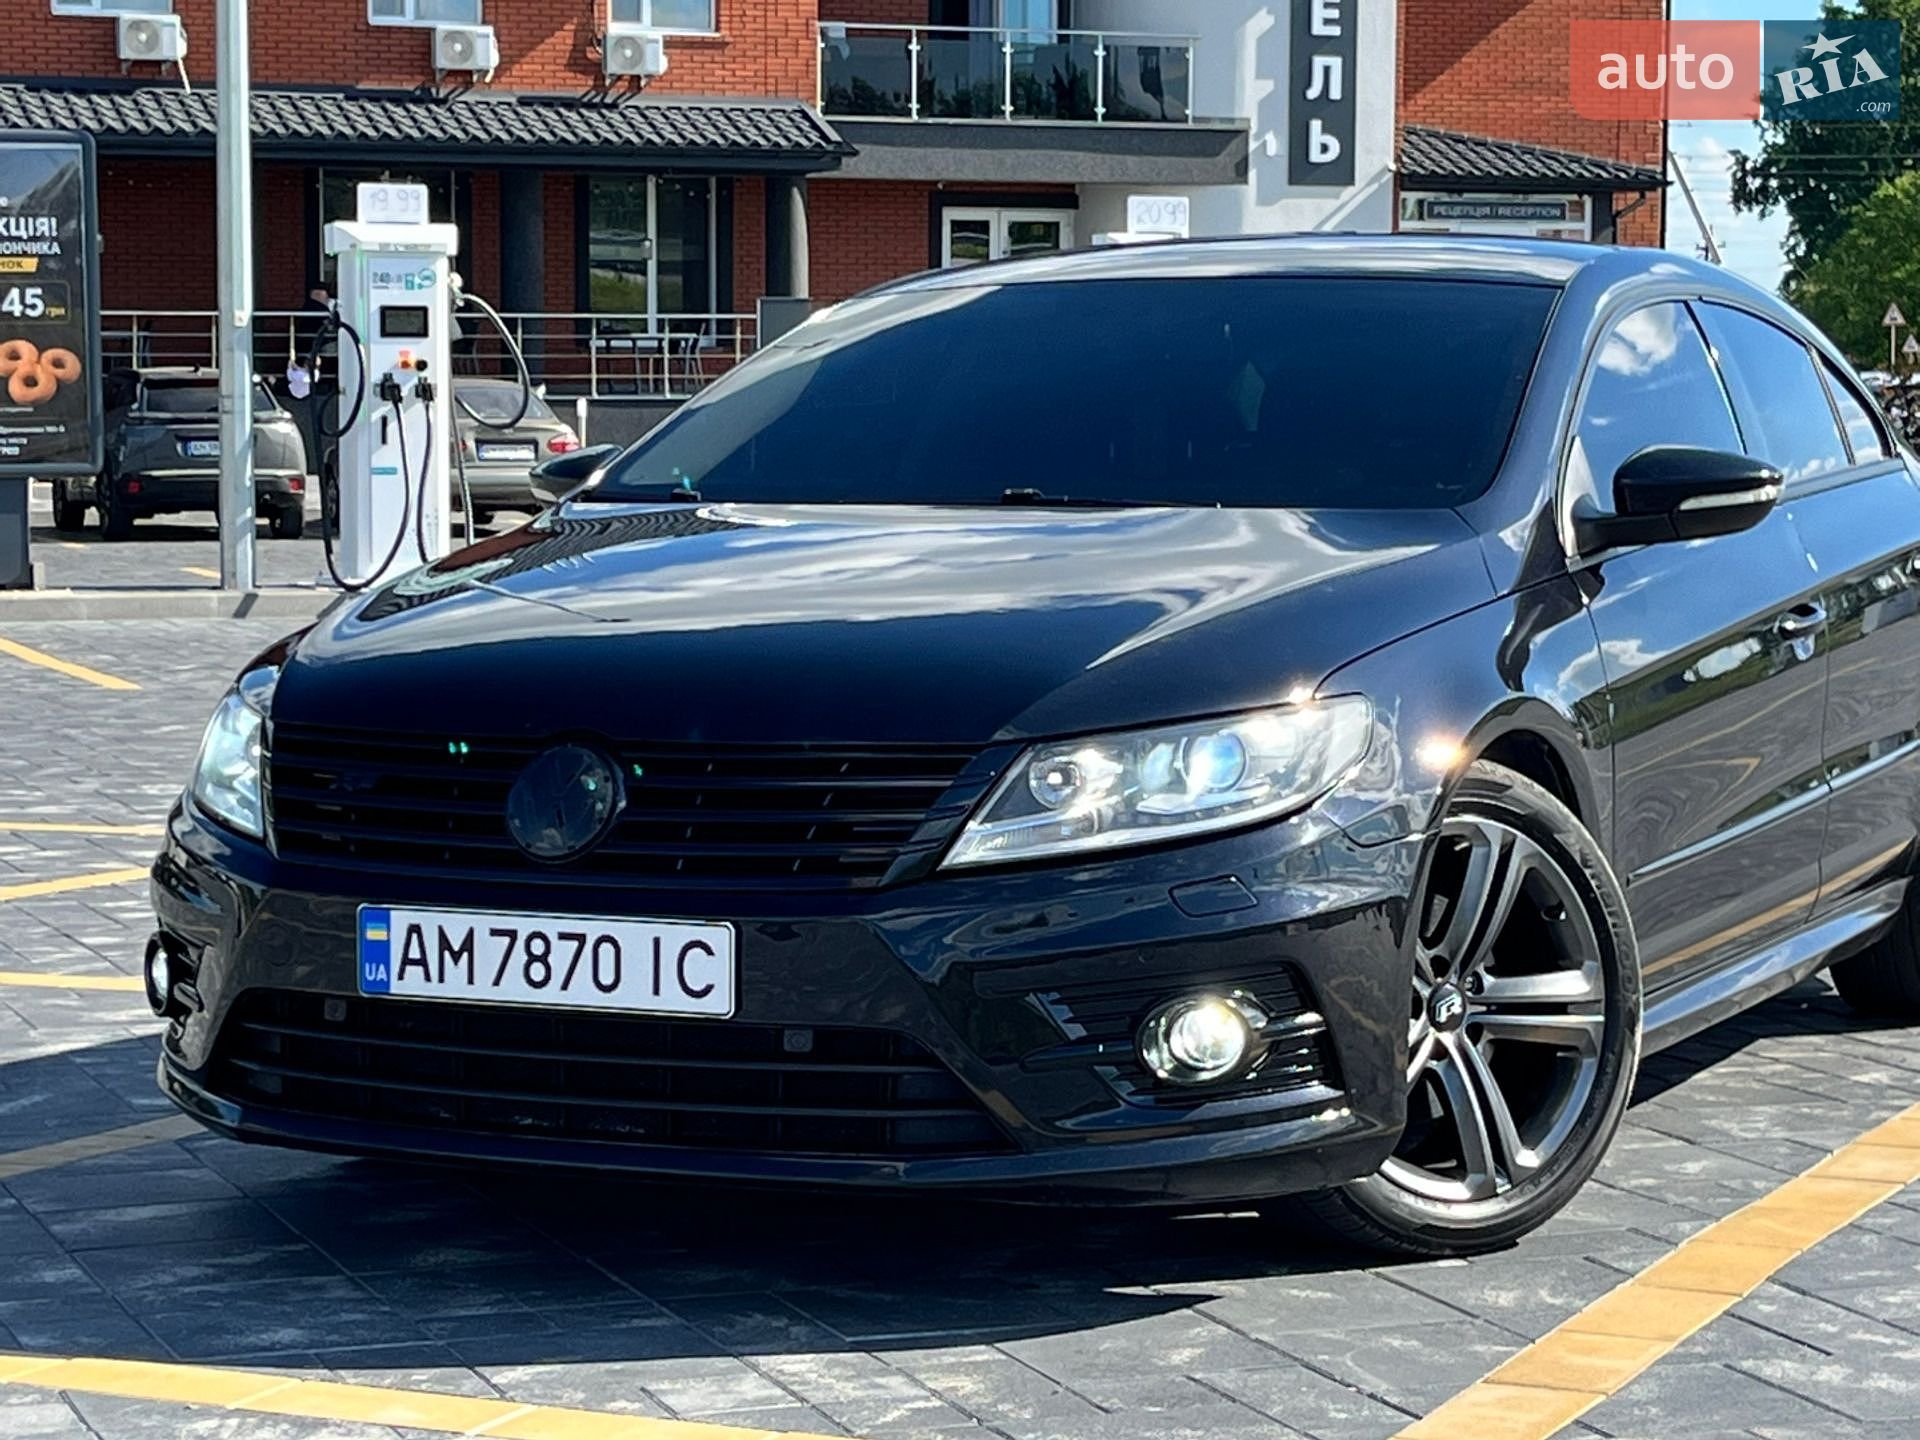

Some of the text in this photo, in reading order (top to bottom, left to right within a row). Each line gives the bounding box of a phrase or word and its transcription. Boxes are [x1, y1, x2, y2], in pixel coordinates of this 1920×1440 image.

[1498, 206, 1561, 218] RECEPTION
[2, 287, 45, 317] 45
[364, 962, 388, 982] UA
[397, 923, 716, 999] AM 7870 IC
